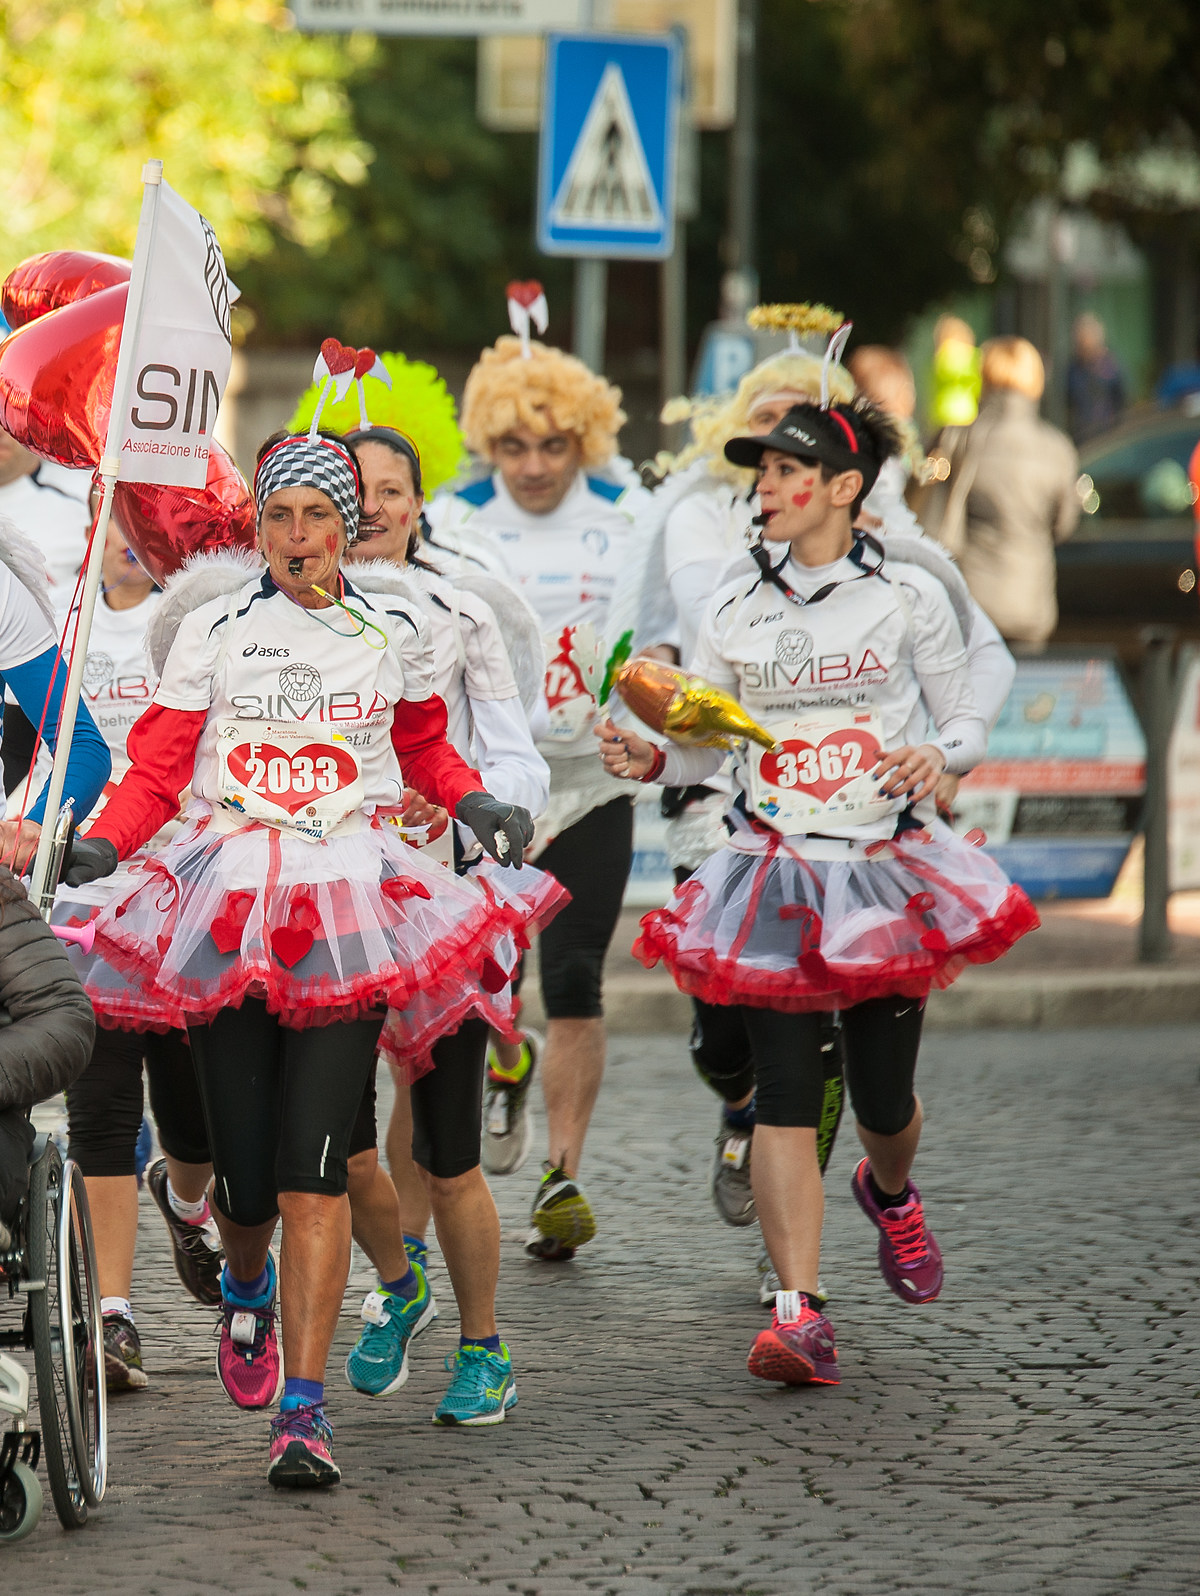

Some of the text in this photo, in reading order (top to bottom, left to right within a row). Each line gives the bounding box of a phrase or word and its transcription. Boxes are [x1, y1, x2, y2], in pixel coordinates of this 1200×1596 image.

[121, 438, 191, 457] Associazione
[257, 647, 290, 657] asics
[743, 648, 889, 688] SIMBA
[230, 690, 388, 722] SIMBA
[99, 714, 141, 728] behc
[250, 743, 263, 759] F
[245, 756, 339, 794] 2033
[776, 740, 865, 789] 3362
